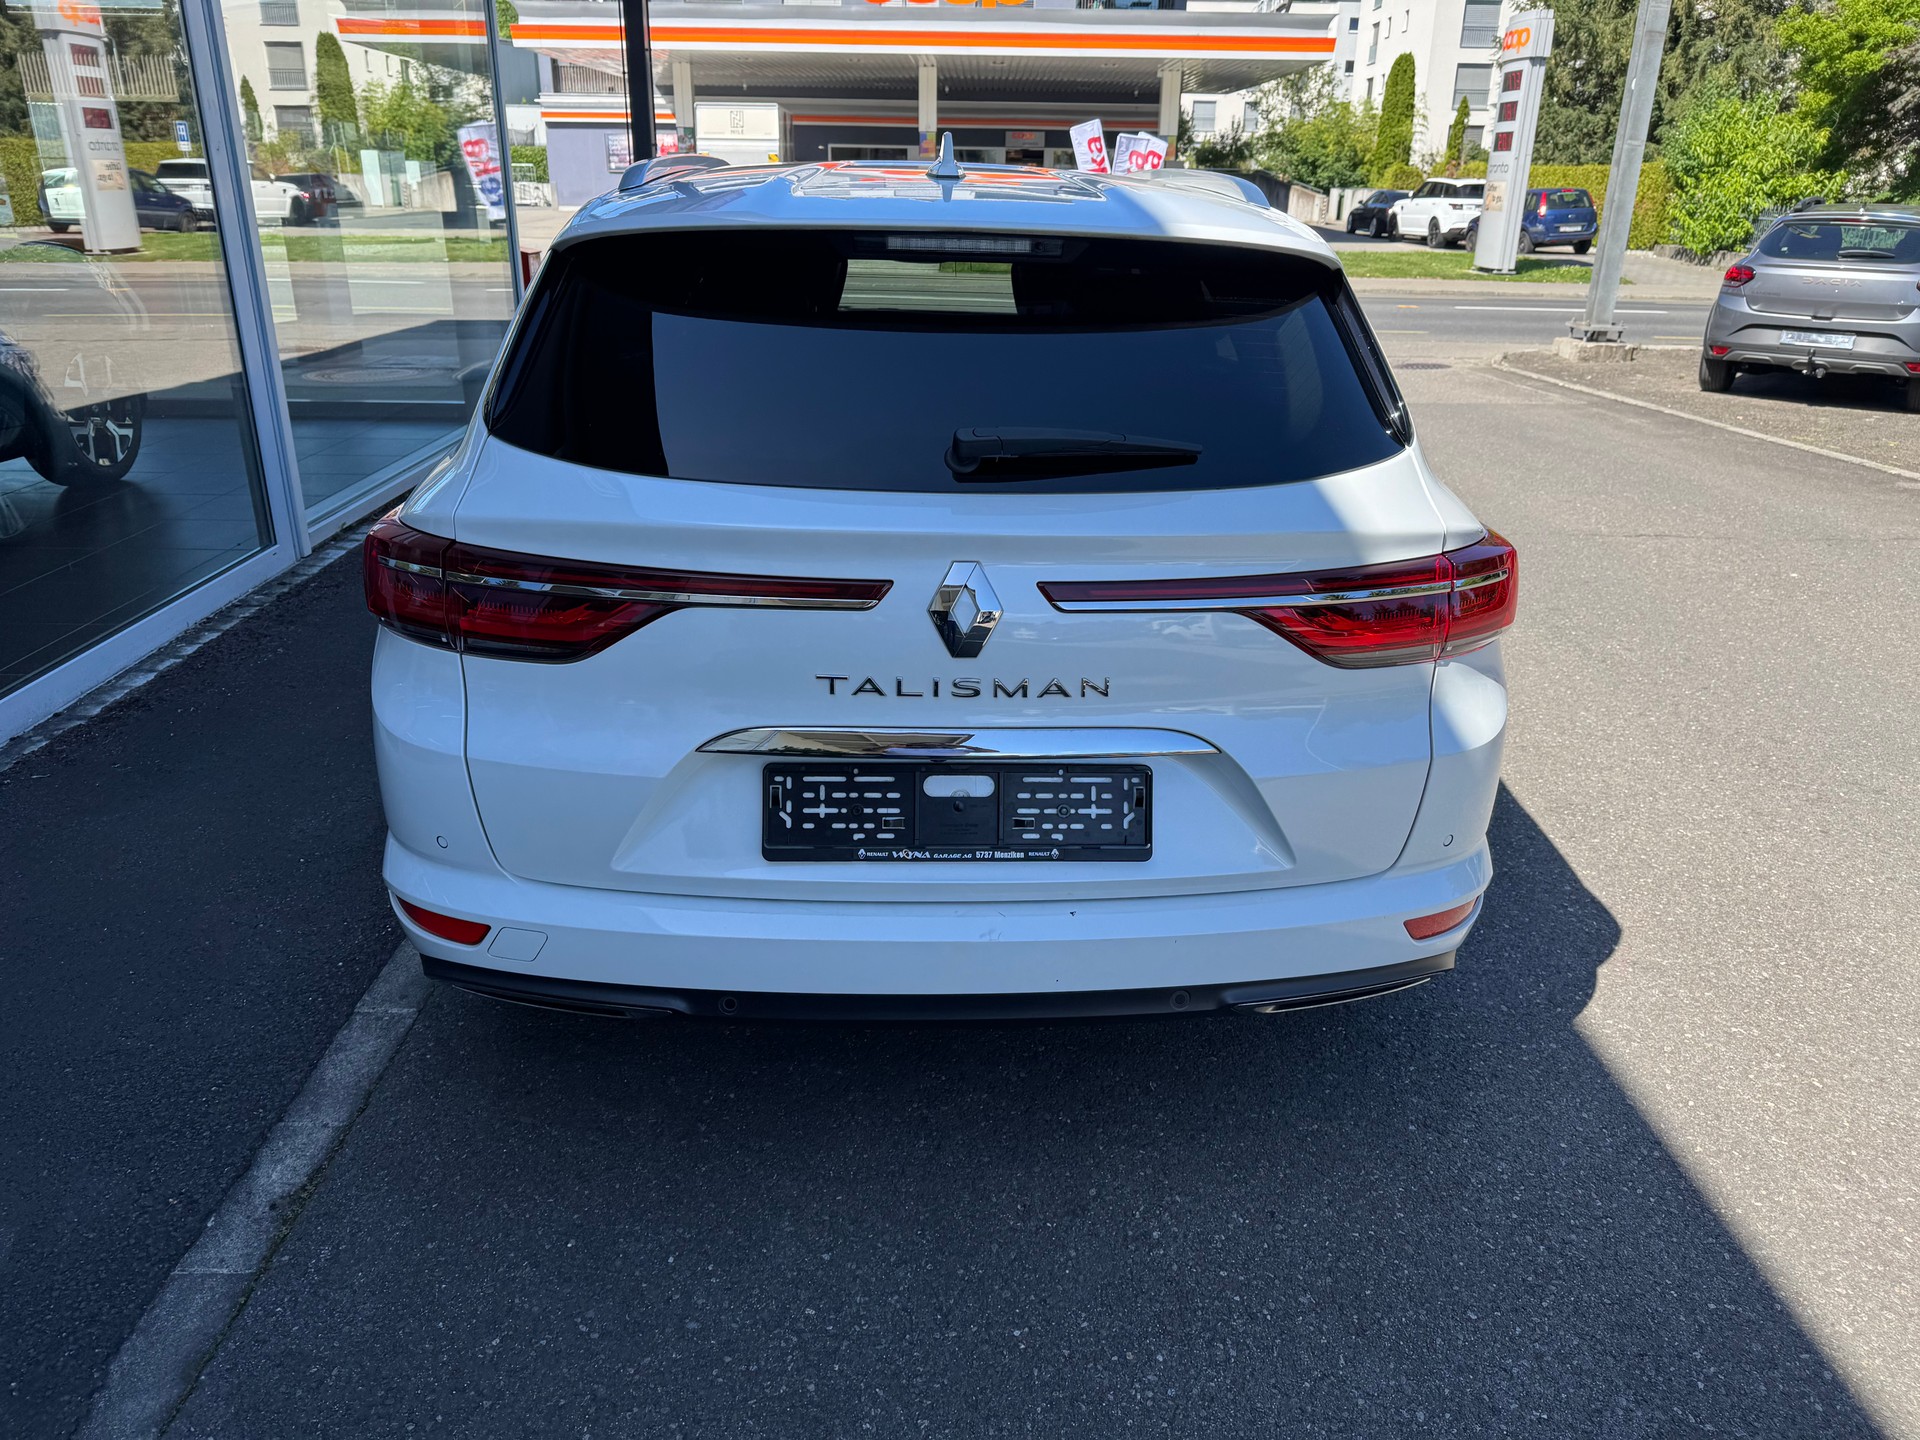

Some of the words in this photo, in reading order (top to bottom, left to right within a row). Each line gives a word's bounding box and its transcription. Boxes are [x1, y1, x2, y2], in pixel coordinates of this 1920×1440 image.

[1801, 276, 1862, 288] DACIA
[815, 674, 1111, 699] TALISMAN
[976, 851, 993, 859] 5737
[994, 851, 1025, 859] Menziken
